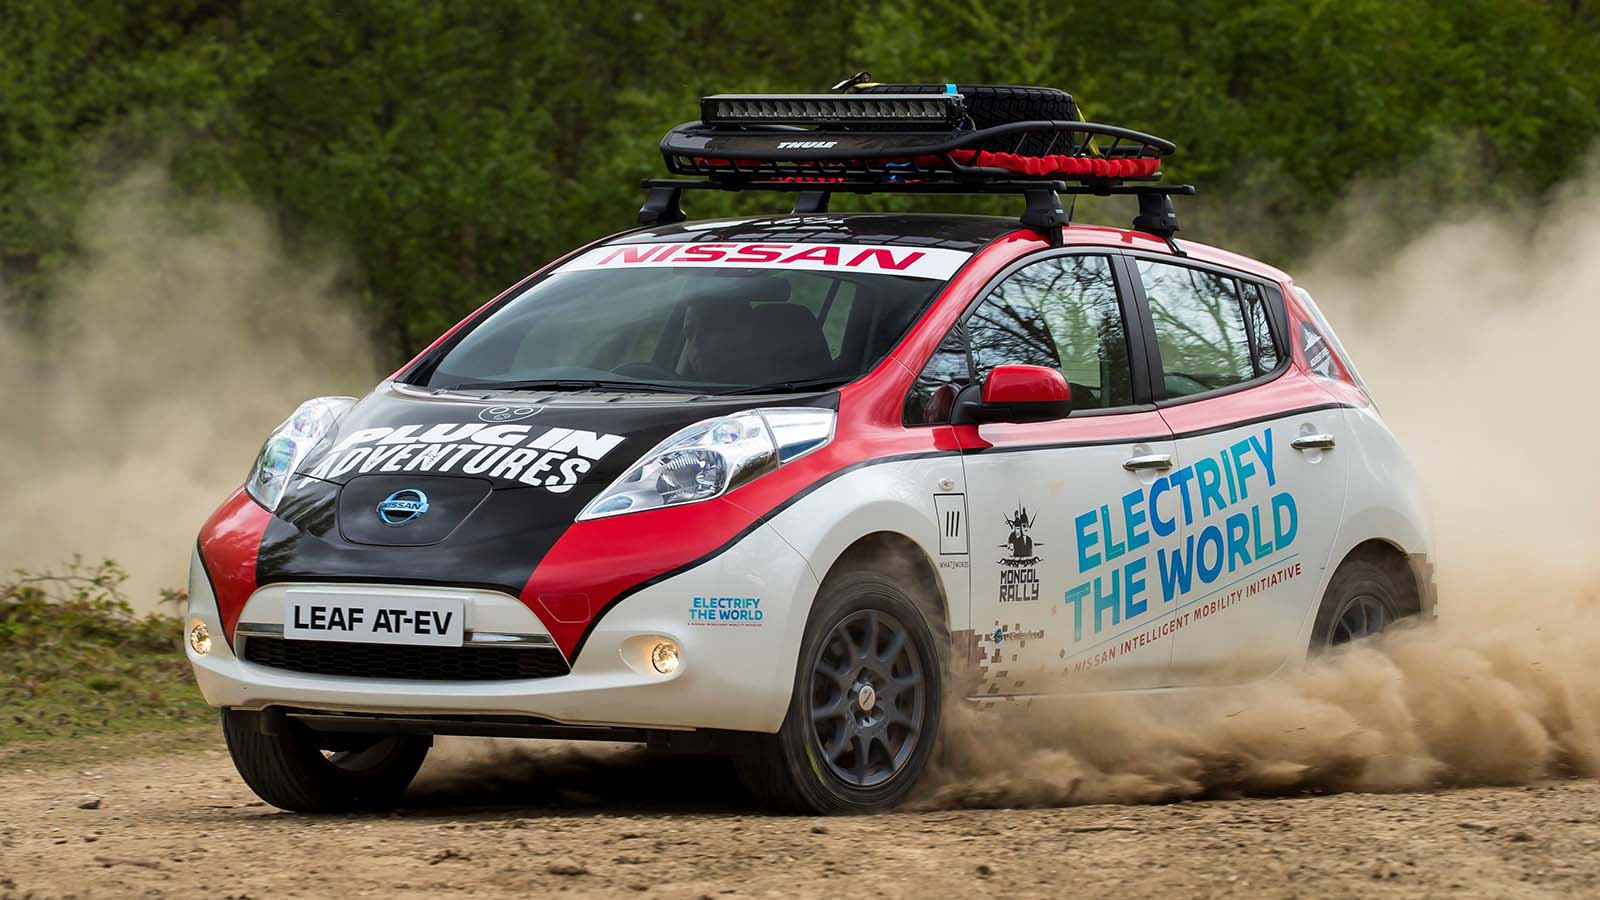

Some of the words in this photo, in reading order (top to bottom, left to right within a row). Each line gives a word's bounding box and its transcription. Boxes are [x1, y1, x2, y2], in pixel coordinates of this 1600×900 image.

[777, 141, 838, 149] THULE
[599, 244, 926, 271] NISSAN
[329, 423, 540, 453] PLUG
[529, 427, 627, 461] IN
[297, 443, 592, 493] ADVENTURES
[381, 502, 424, 510] NISSAN
[1074, 428, 1276, 574] ELECTRIFY
[1000, 568, 1040, 585] MONGOL
[1064, 556, 1148, 642] THE
[1157, 491, 1298, 603] WORLD
[693, 597, 761, 609] ELECTRIFY
[999, 583, 1040, 603] RALLY
[294, 605, 364, 631] LEAF
[372, 608, 453, 635] AT-EV
[688, 609, 717, 620] THE
[719, 609, 763, 621] WORLD
[1073, 647, 1116, 673] NISSAN
[1120, 613, 1190, 656] INTELLIGENT
[1193, 589, 1242, 622] MOBILITY
[1246, 562, 1301, 598] INITIATIVE
